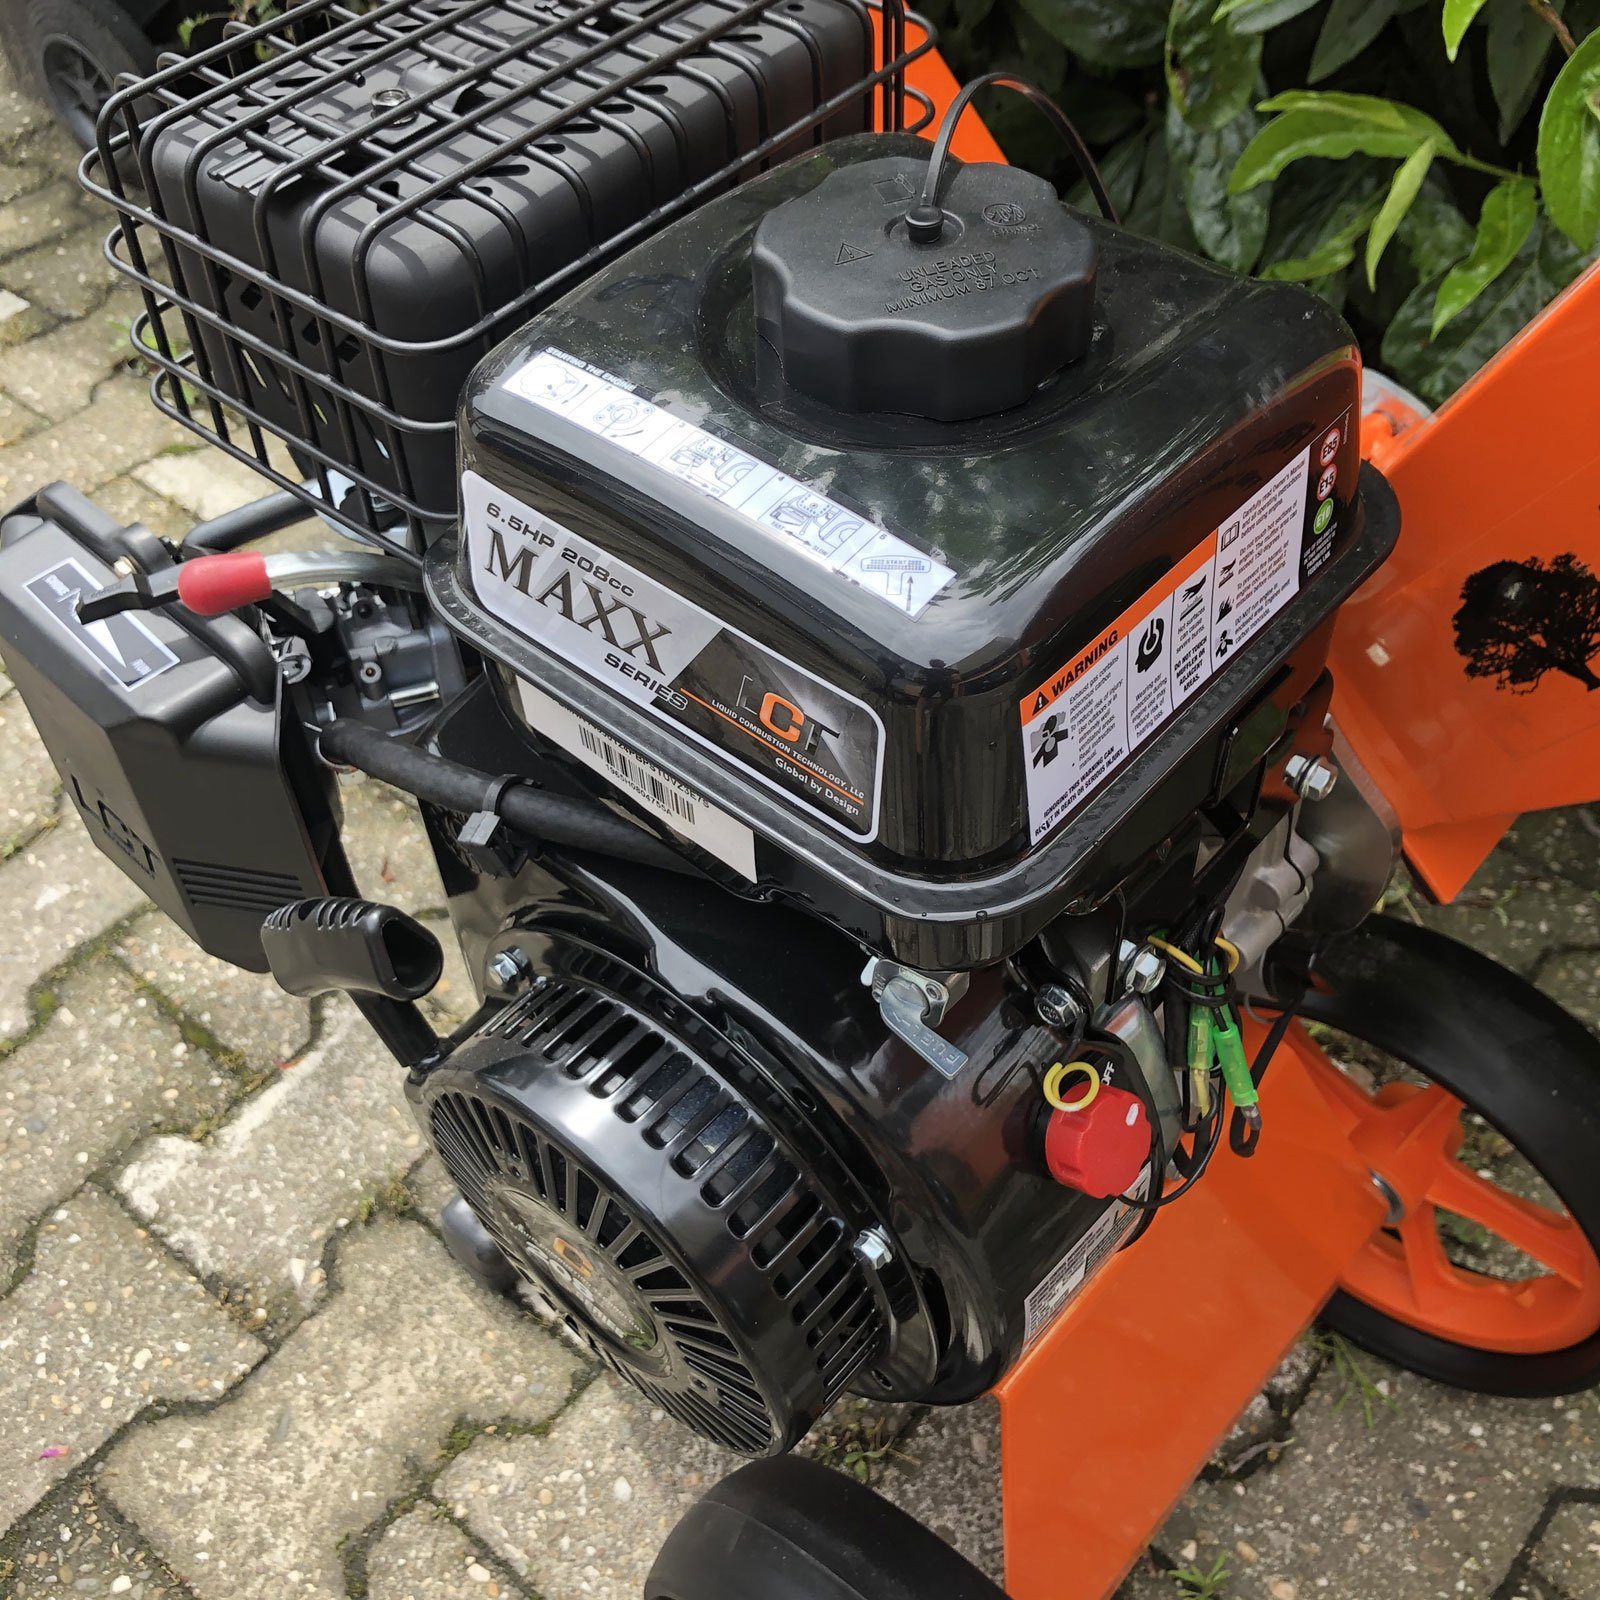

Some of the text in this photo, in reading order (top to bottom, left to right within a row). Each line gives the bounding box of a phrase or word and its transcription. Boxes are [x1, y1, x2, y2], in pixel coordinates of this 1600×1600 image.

[898, 250, 997, 282] UNLEADED
[910, 263, 998, 292] GAS ONLY
[884, 266, 1040, 314] MINIMUM 87 OCT
[545, 346, 637, 392] STARTING THE ENGINE
[1322, 435, 1338, 460] E85
[1243, 458, 1305, 519] Carefully read Owner's Manual
[1320, 471, 1334, 493] E15
[1240, 499, 1298, 556] Do not touch hot sections of
[1241, 517, 1251, 529] and
[1257, 494, 1278, 515] operating
[1241, 523, 1256, 539] before
[1255, 511, 1268, 526] using
[1255, 540, 1264, 551] The
[1263, 526, 1280, 543] muffler
[1279, 517, 1290, 529] area
[1289, 509, 1298, 520] can
[486, 502, 635, 597] 6.5HP 208cc
[1235, 591, 1254, 609] minutes
[1253, 577, 1267, 593] before
[1236, 583, 1251, 600] engine
[1251, 575, 1261, 587] cool
[1268, 563, 1273, 572] at
[1272, 553, 1284, 567] least
[1237, 582, 1243, 590] To
[1242, 567, 1259, 586] prevent
[1259, 561, 1267, 570] fire
[484, 523, 673, 676] MAXX
[1186, 606, 1205, 626] surfaces
[1234, 615, 1241, 626] DO
[1242, 606, 1252, 618] NOT
[1251, 600, 1259, 611] run
[1259, 587, 1274, 604] engine
[1176, 638, 1190, 654] severe
[1180, 617, 1203, 641] can cause
[1235, 627, 1250, 644] carbon
[1051, 629, 1118, 697] WARNING
[1174, 635, 1208, 671] DO NOT TOUCH
[1176, 648, 1206, 679] MUFFLER OR
[1179, 658, 1204, 687] ADJACENT
[604, 652, 688, 711] SERIES
[1070, 655, 1119, 705] Exhaust gas contains
[1070, 672, 1111, 716] poisonous carbon
[1130, 677, 1168, 718] protection during
[1135, 680, 1154, 701] Wearing
[736, 674, 841, 757] LCT
[1071, 724, 1076, 732] To
[1077, 708, 1093, 726] reduce
[1094, 699, 1103, 710] risk
[1104, 691, 1108, 701] of
[1079, 693, 1117, 734] Use outdoors or in
[1079, 707, 1110, 743] extremely well
[1132, 688, 1166, 724] engine use may
[1134, 696, 1165, 731] reduce risk of
[711, 699, 865, 799] LIQUID COMBUSTION TECHNOLOGY, LLC
[1079, 727, 1101, 751] ventilated
[1079, 722, 1115, 761] Read instruction
[1136, 720, 1153, 739] hearing
[775, 757, 860, 816] Global by Design
[1043, 746, 1114, 817] IGNORING THIS WARNING CAN
[1054, 810, 1060, 818] IN
[1061, 793, 1076, 812] DEATH
[1077, 787, 1084, 796] OR
[1085, 765, 1105, 788] SERIOUS
[912, 1024, 960, 1064] FUEL
